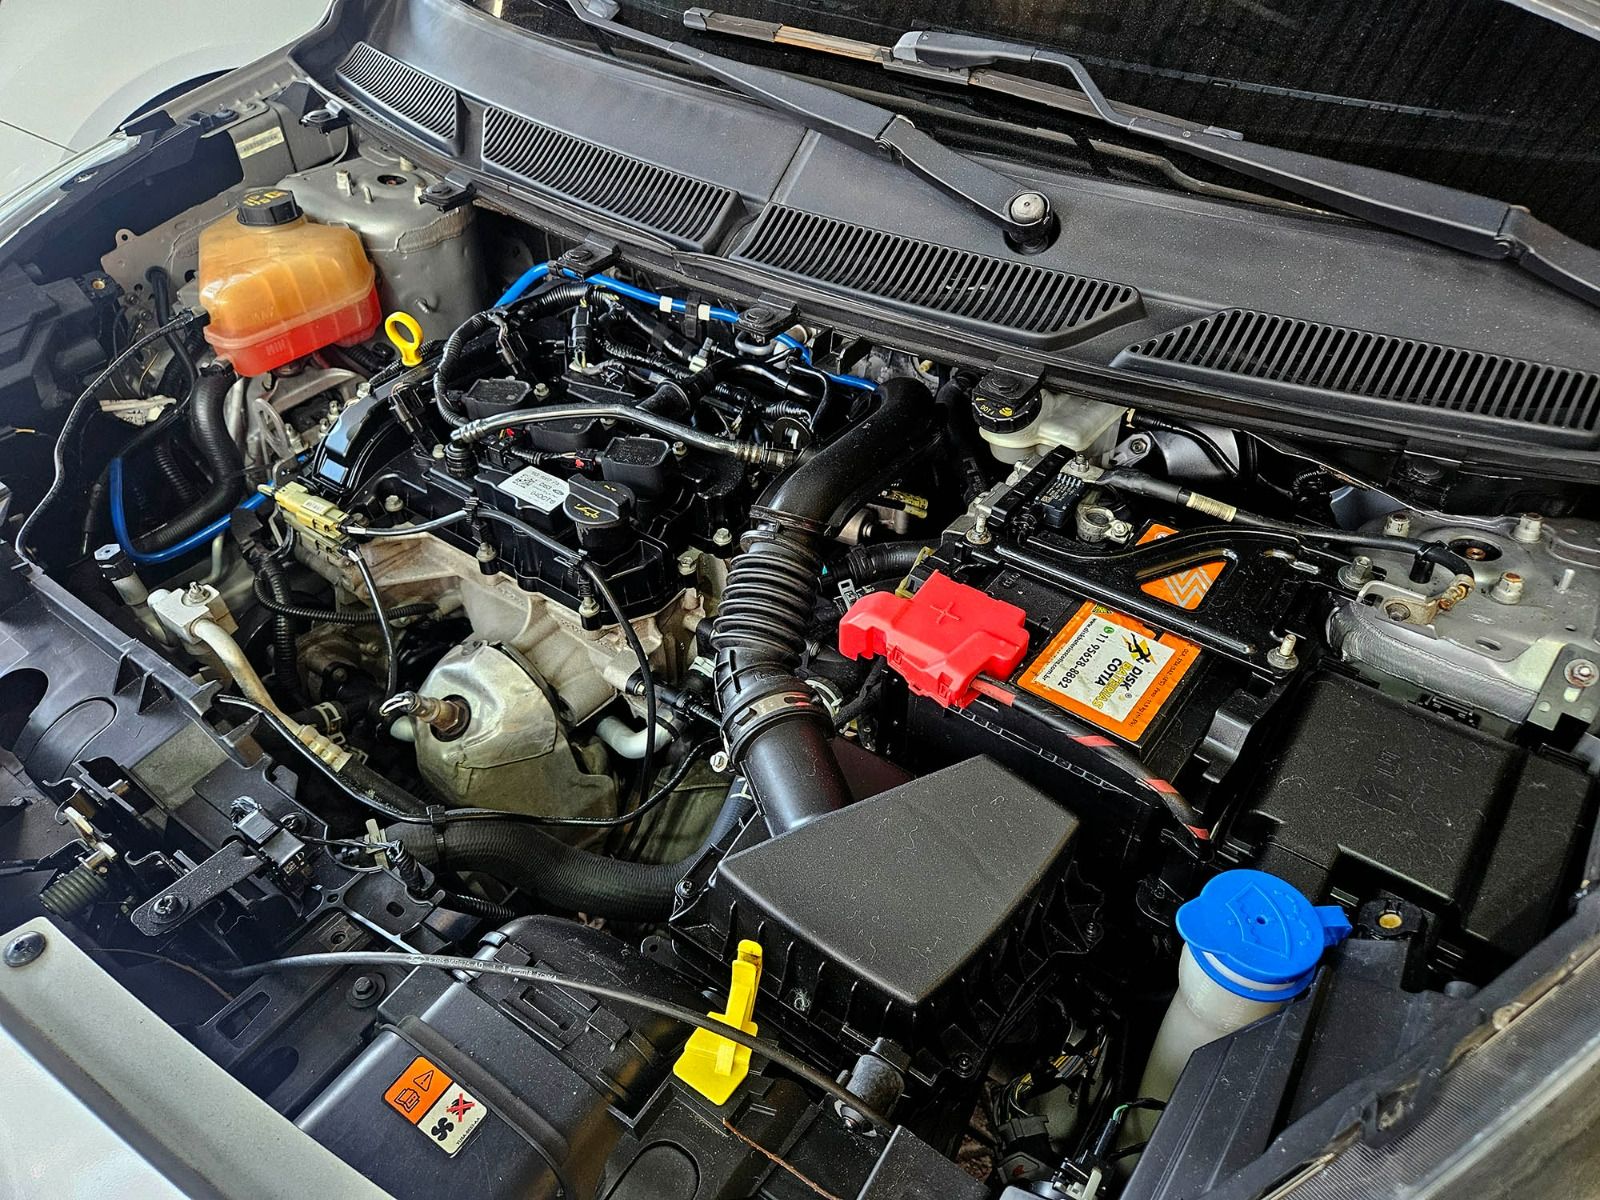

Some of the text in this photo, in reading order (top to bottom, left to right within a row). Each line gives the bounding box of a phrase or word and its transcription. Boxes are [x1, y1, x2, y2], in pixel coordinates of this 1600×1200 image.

[981, 405, 991, 413] DOT
[1094, 632, 1108, 643] 11
[1058, 644, 1100, 689] 95628-8882
[1095, 658, 1123, 686] COTIA
[1120, 666, 1143, 691] DISK
[1092, 661, 1133, 709] BATERIAS
